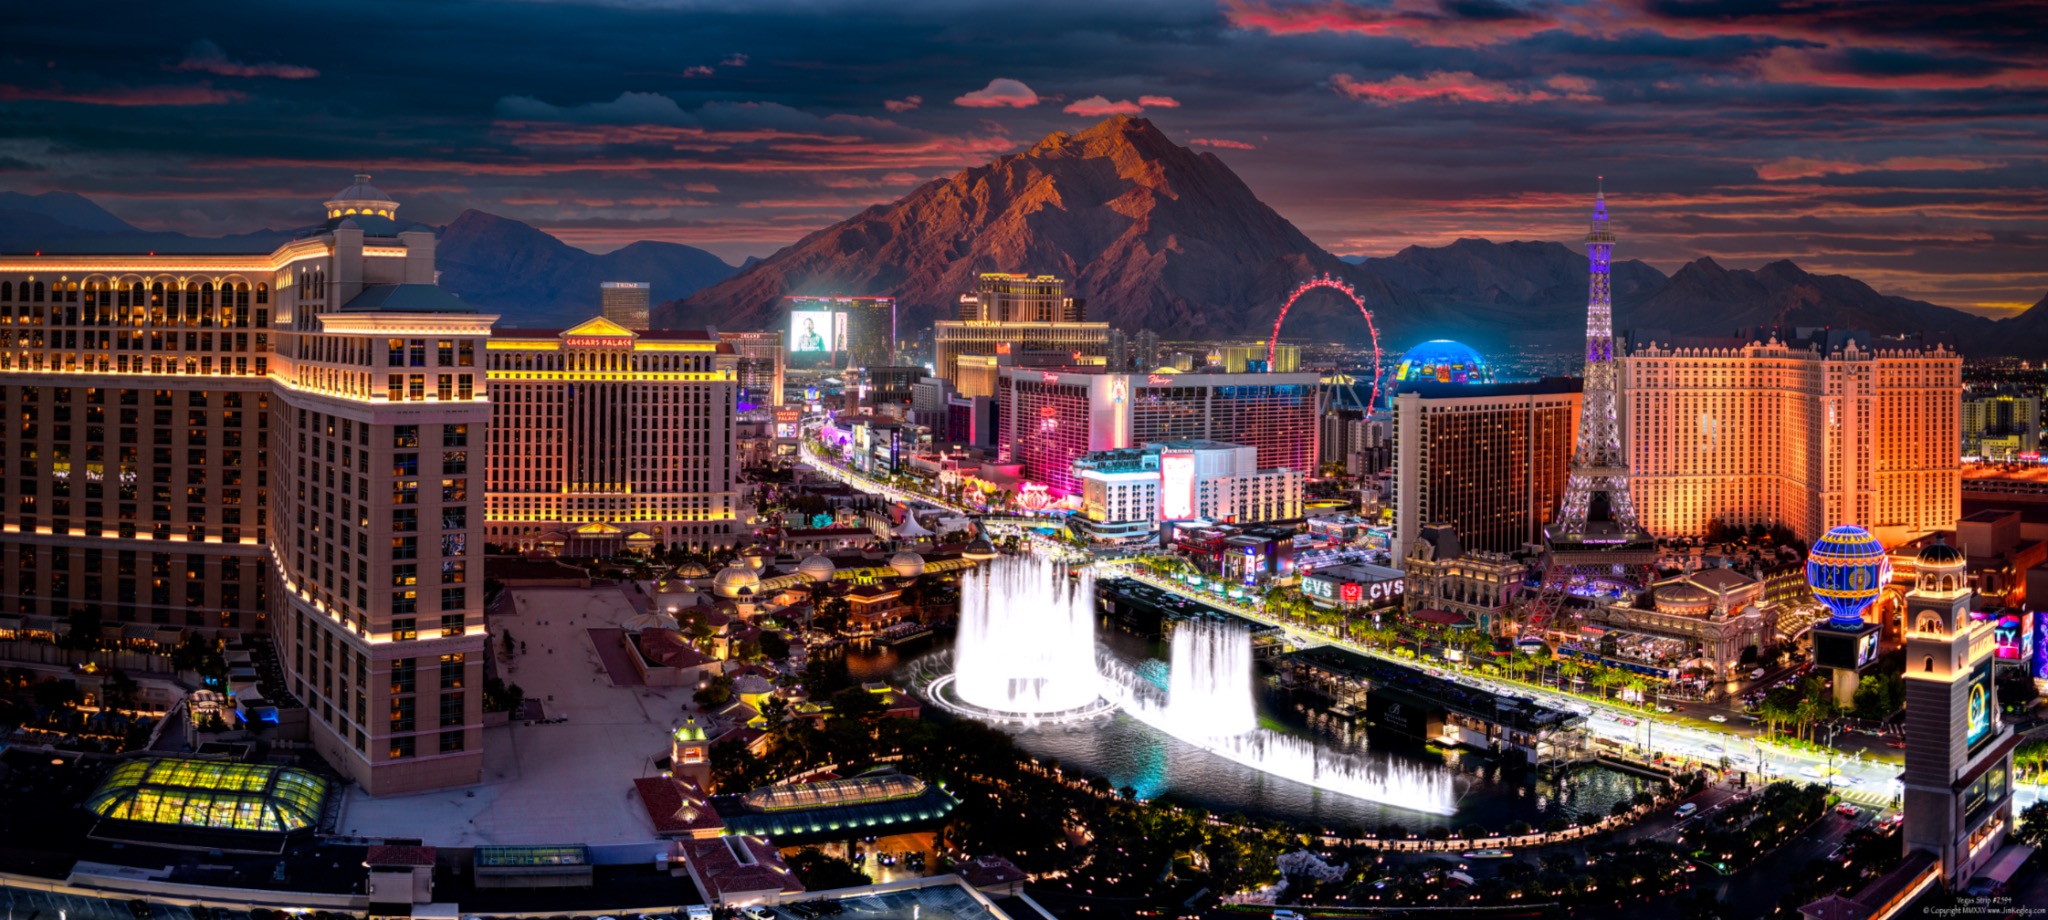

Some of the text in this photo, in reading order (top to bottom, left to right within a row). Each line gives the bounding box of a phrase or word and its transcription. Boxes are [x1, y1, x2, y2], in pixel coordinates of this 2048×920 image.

[566, 338, 632, 346] CAESARS PALACE
[1302, 577, 1333, 598] CVS
[1369, 579, 1404, 599] CVS
